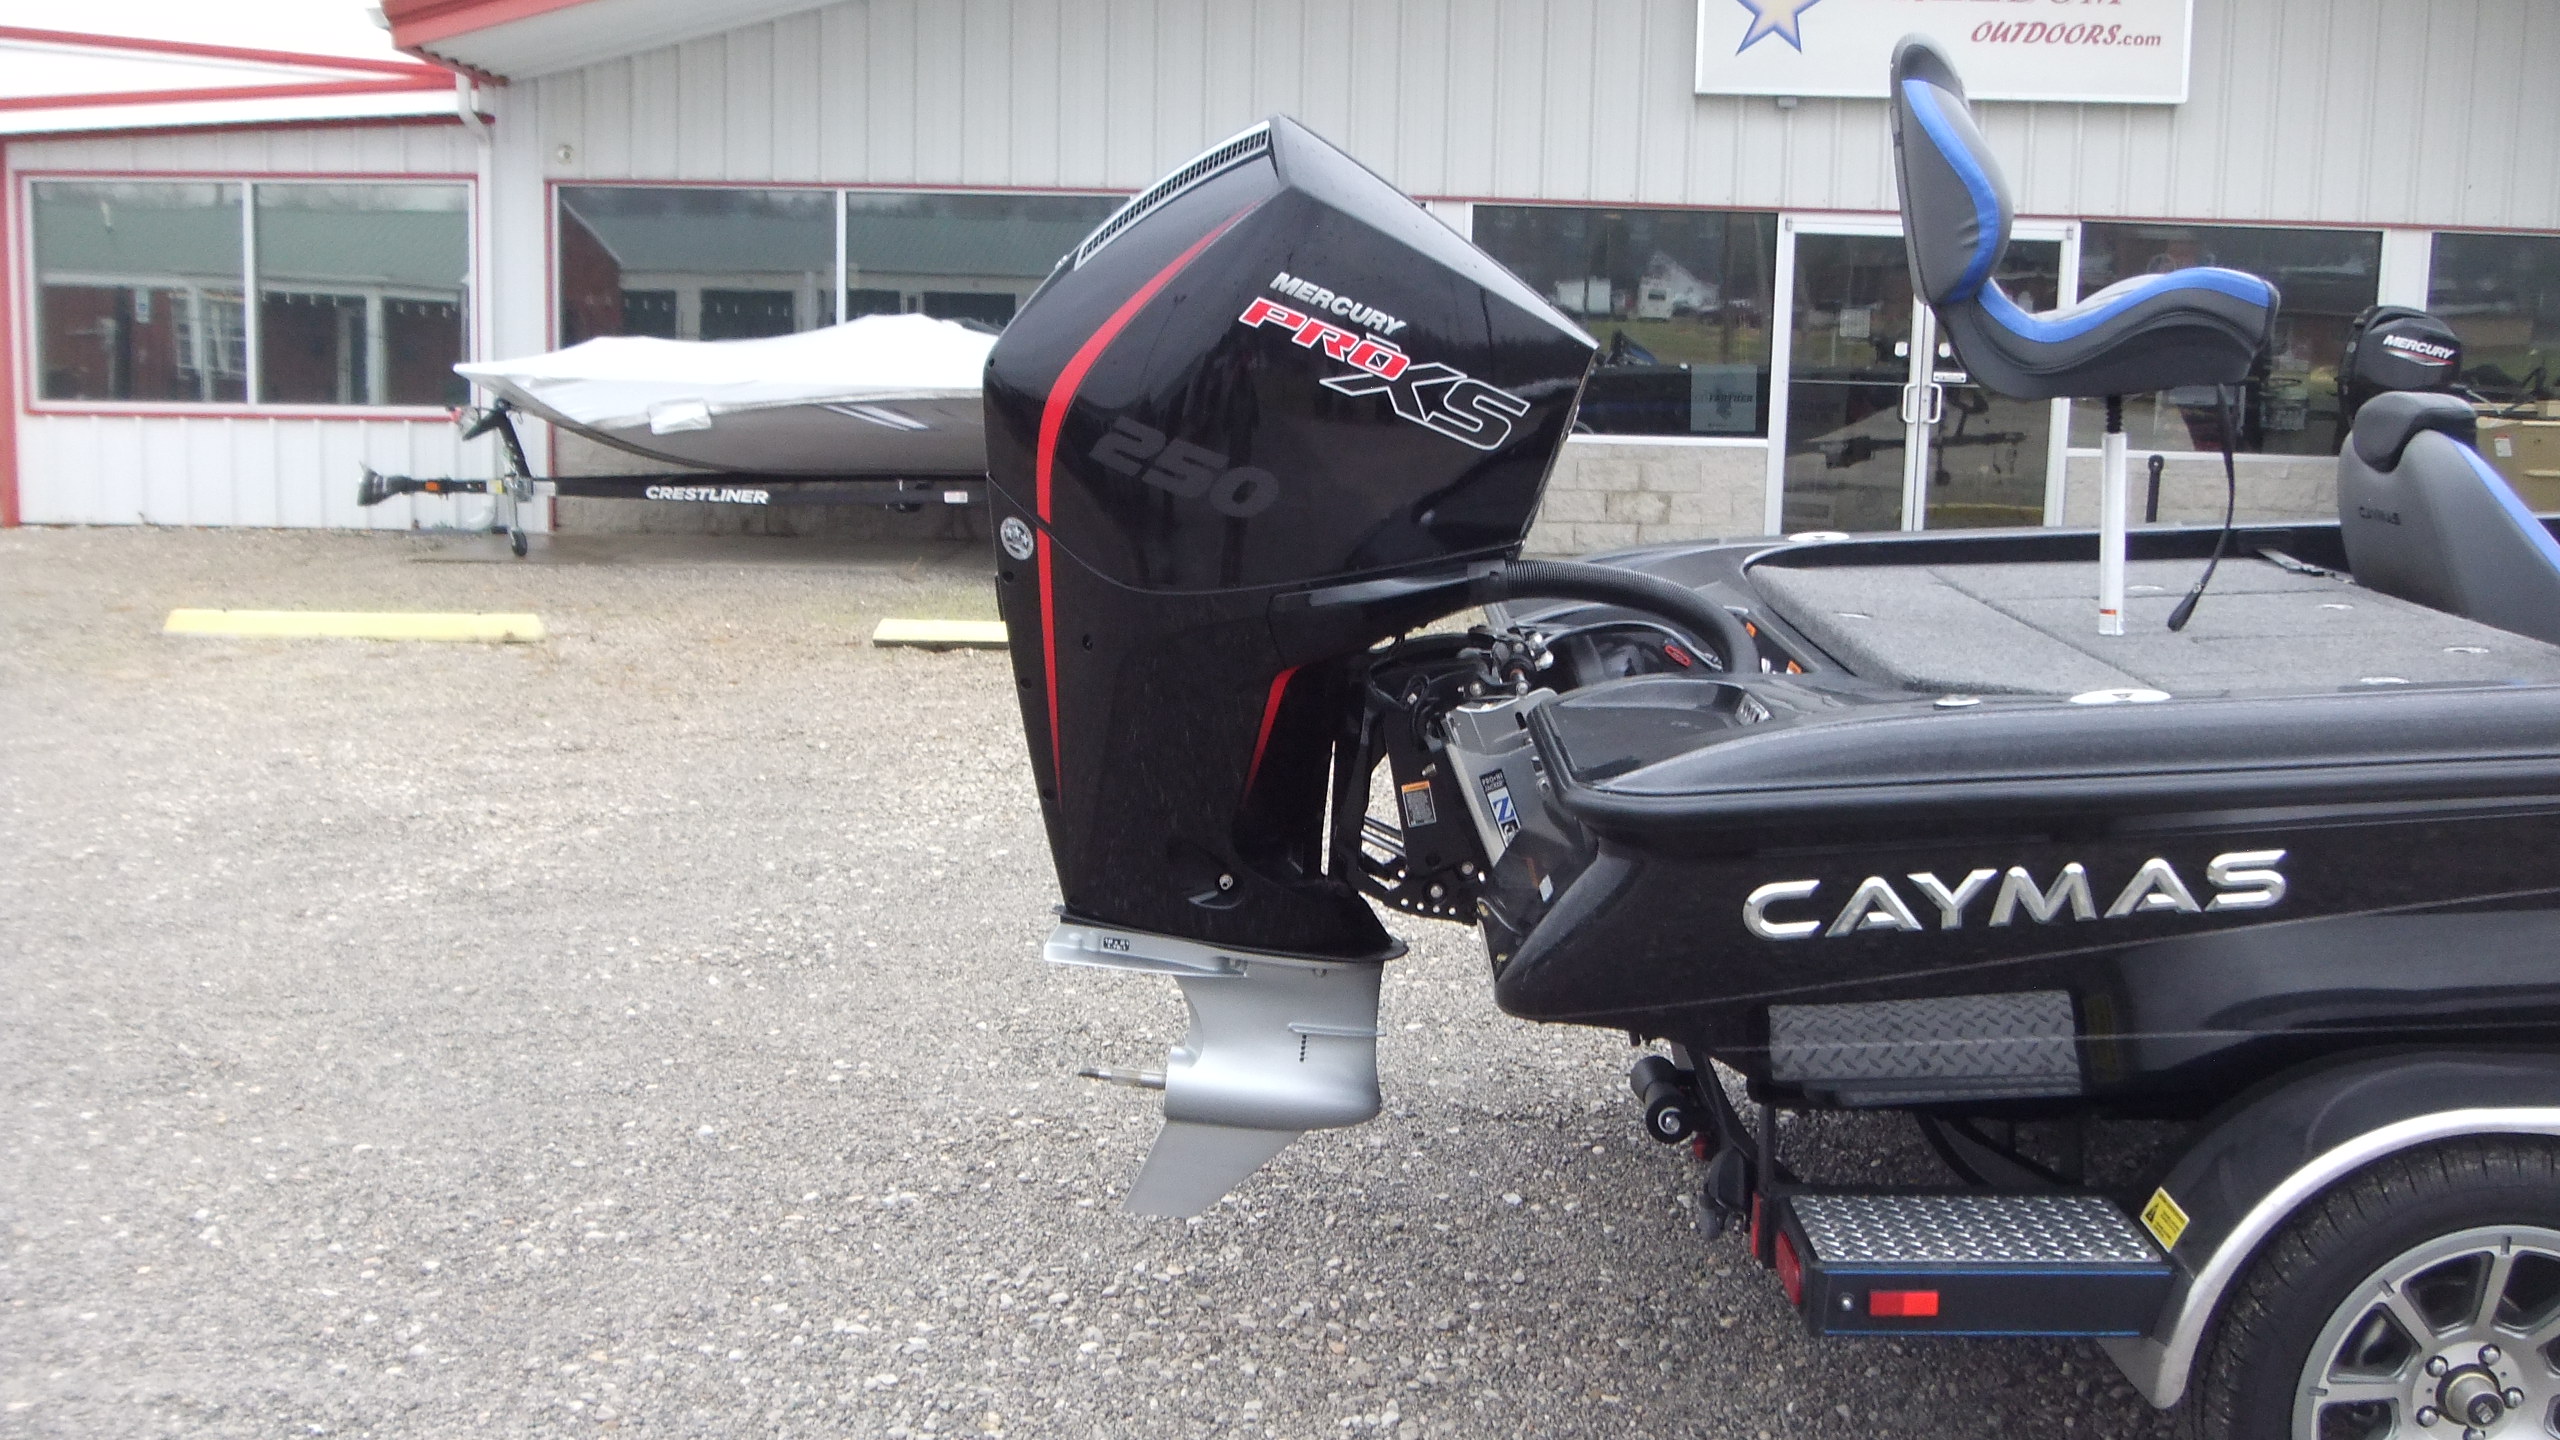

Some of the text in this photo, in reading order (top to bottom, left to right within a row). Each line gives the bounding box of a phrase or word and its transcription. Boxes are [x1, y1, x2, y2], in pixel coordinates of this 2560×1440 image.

[1971, 20, 2162, 47] OUTDOORS.com
[1269, 272, 1406, 335] MERCURY
[1239, 297, 1411, 381] PRO
[2382, 334, 2455, 359] MERCURY
[645, 485, 770, 504] CRESTLINER
[1088, 416, 1280, 519] 250
[1743, 849, 2287, 942] CAYMAS
